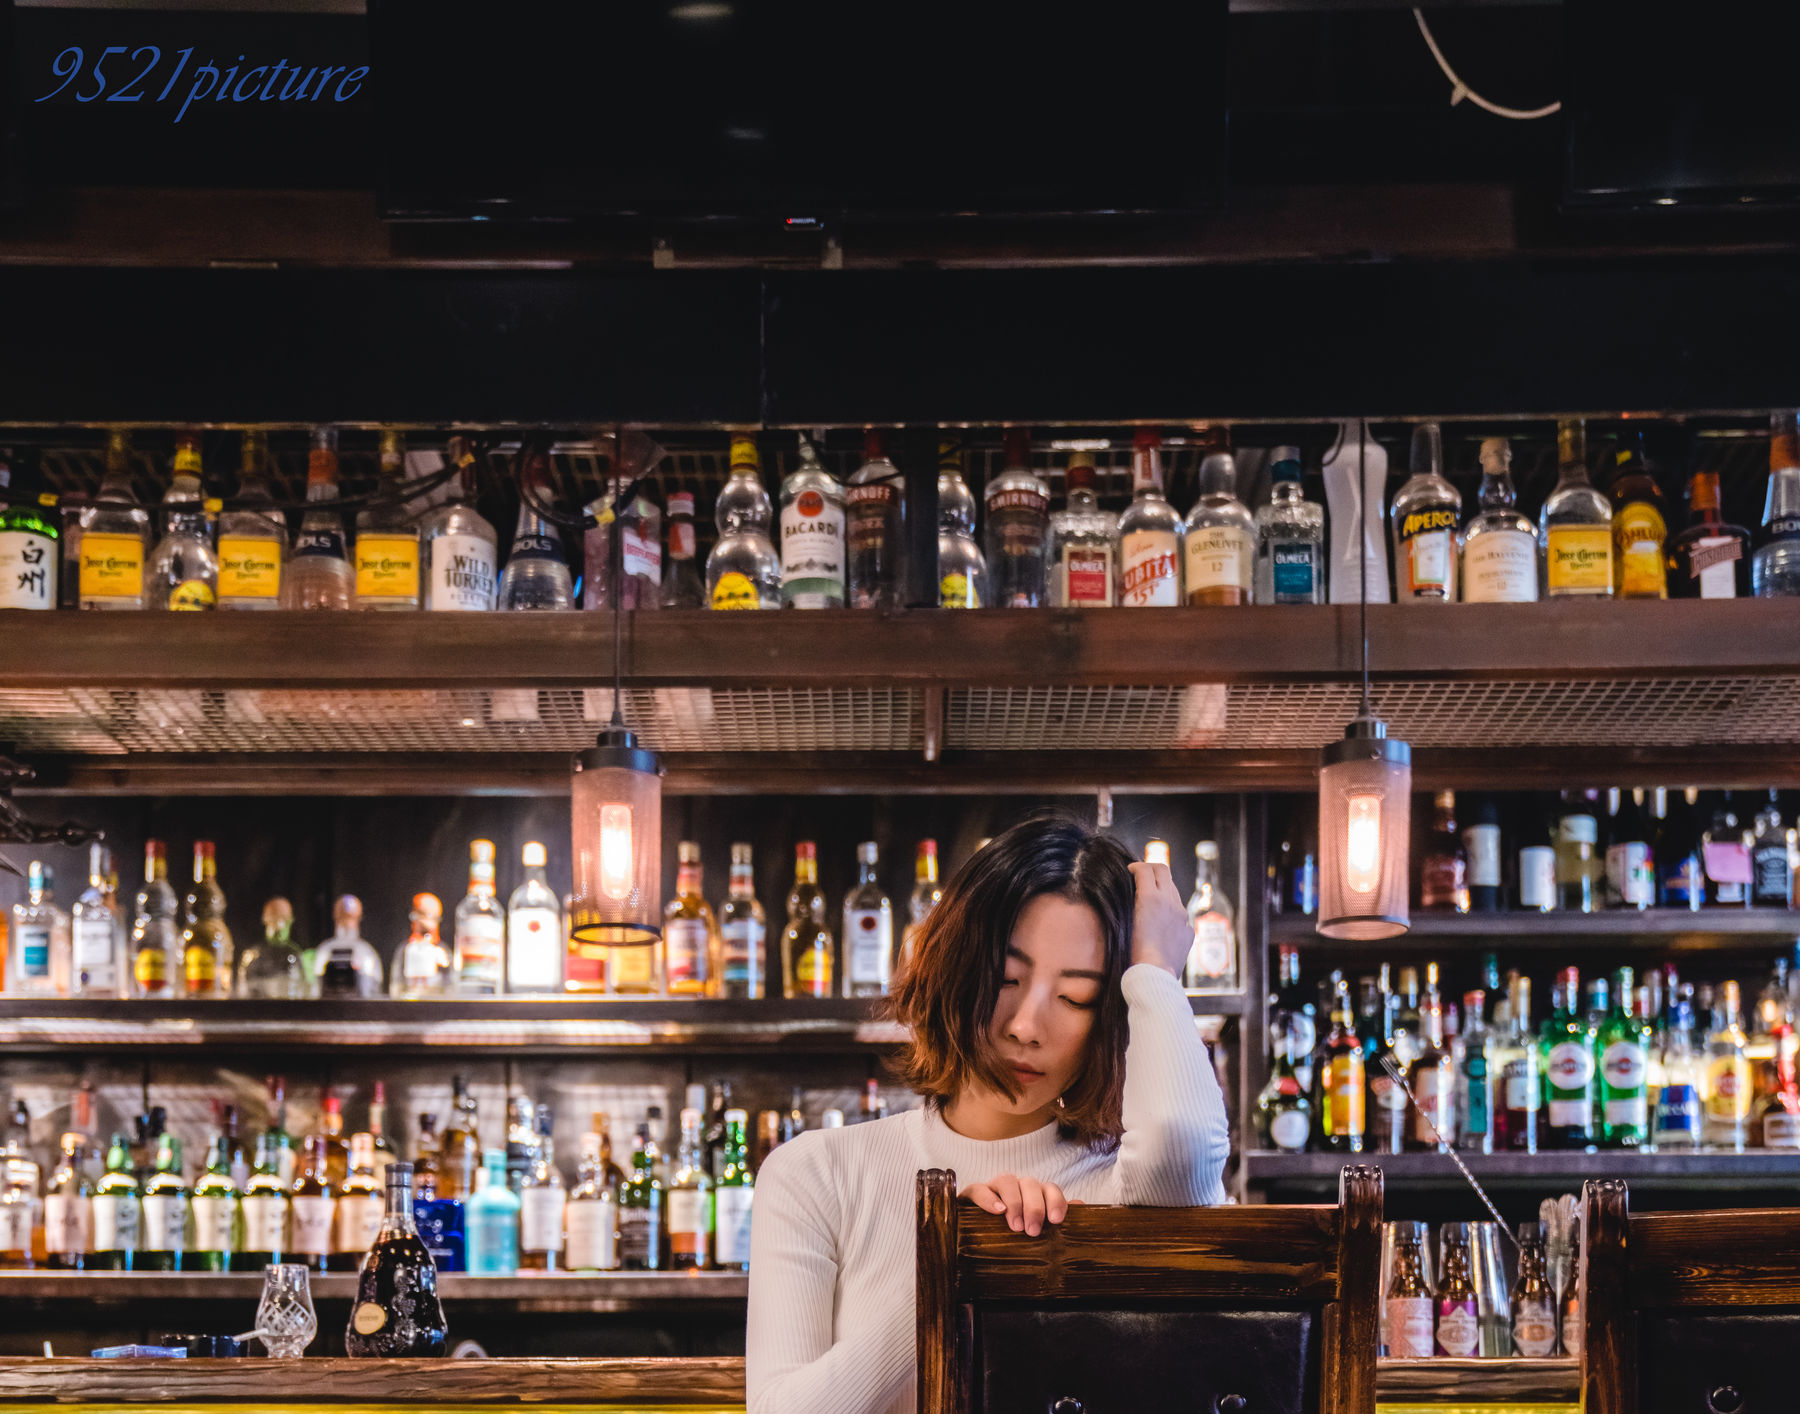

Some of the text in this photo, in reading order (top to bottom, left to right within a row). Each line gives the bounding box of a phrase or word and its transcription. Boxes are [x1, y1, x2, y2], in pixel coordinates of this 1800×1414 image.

[785, 521, 839, 538] BACARDI
[1402, 511, 1457, 537] APEROL
[453, 554, 489, 574] WILD
[1274, 551, 1311, 565] OLMECA
[444, 566, 494, 596] TURKEY
